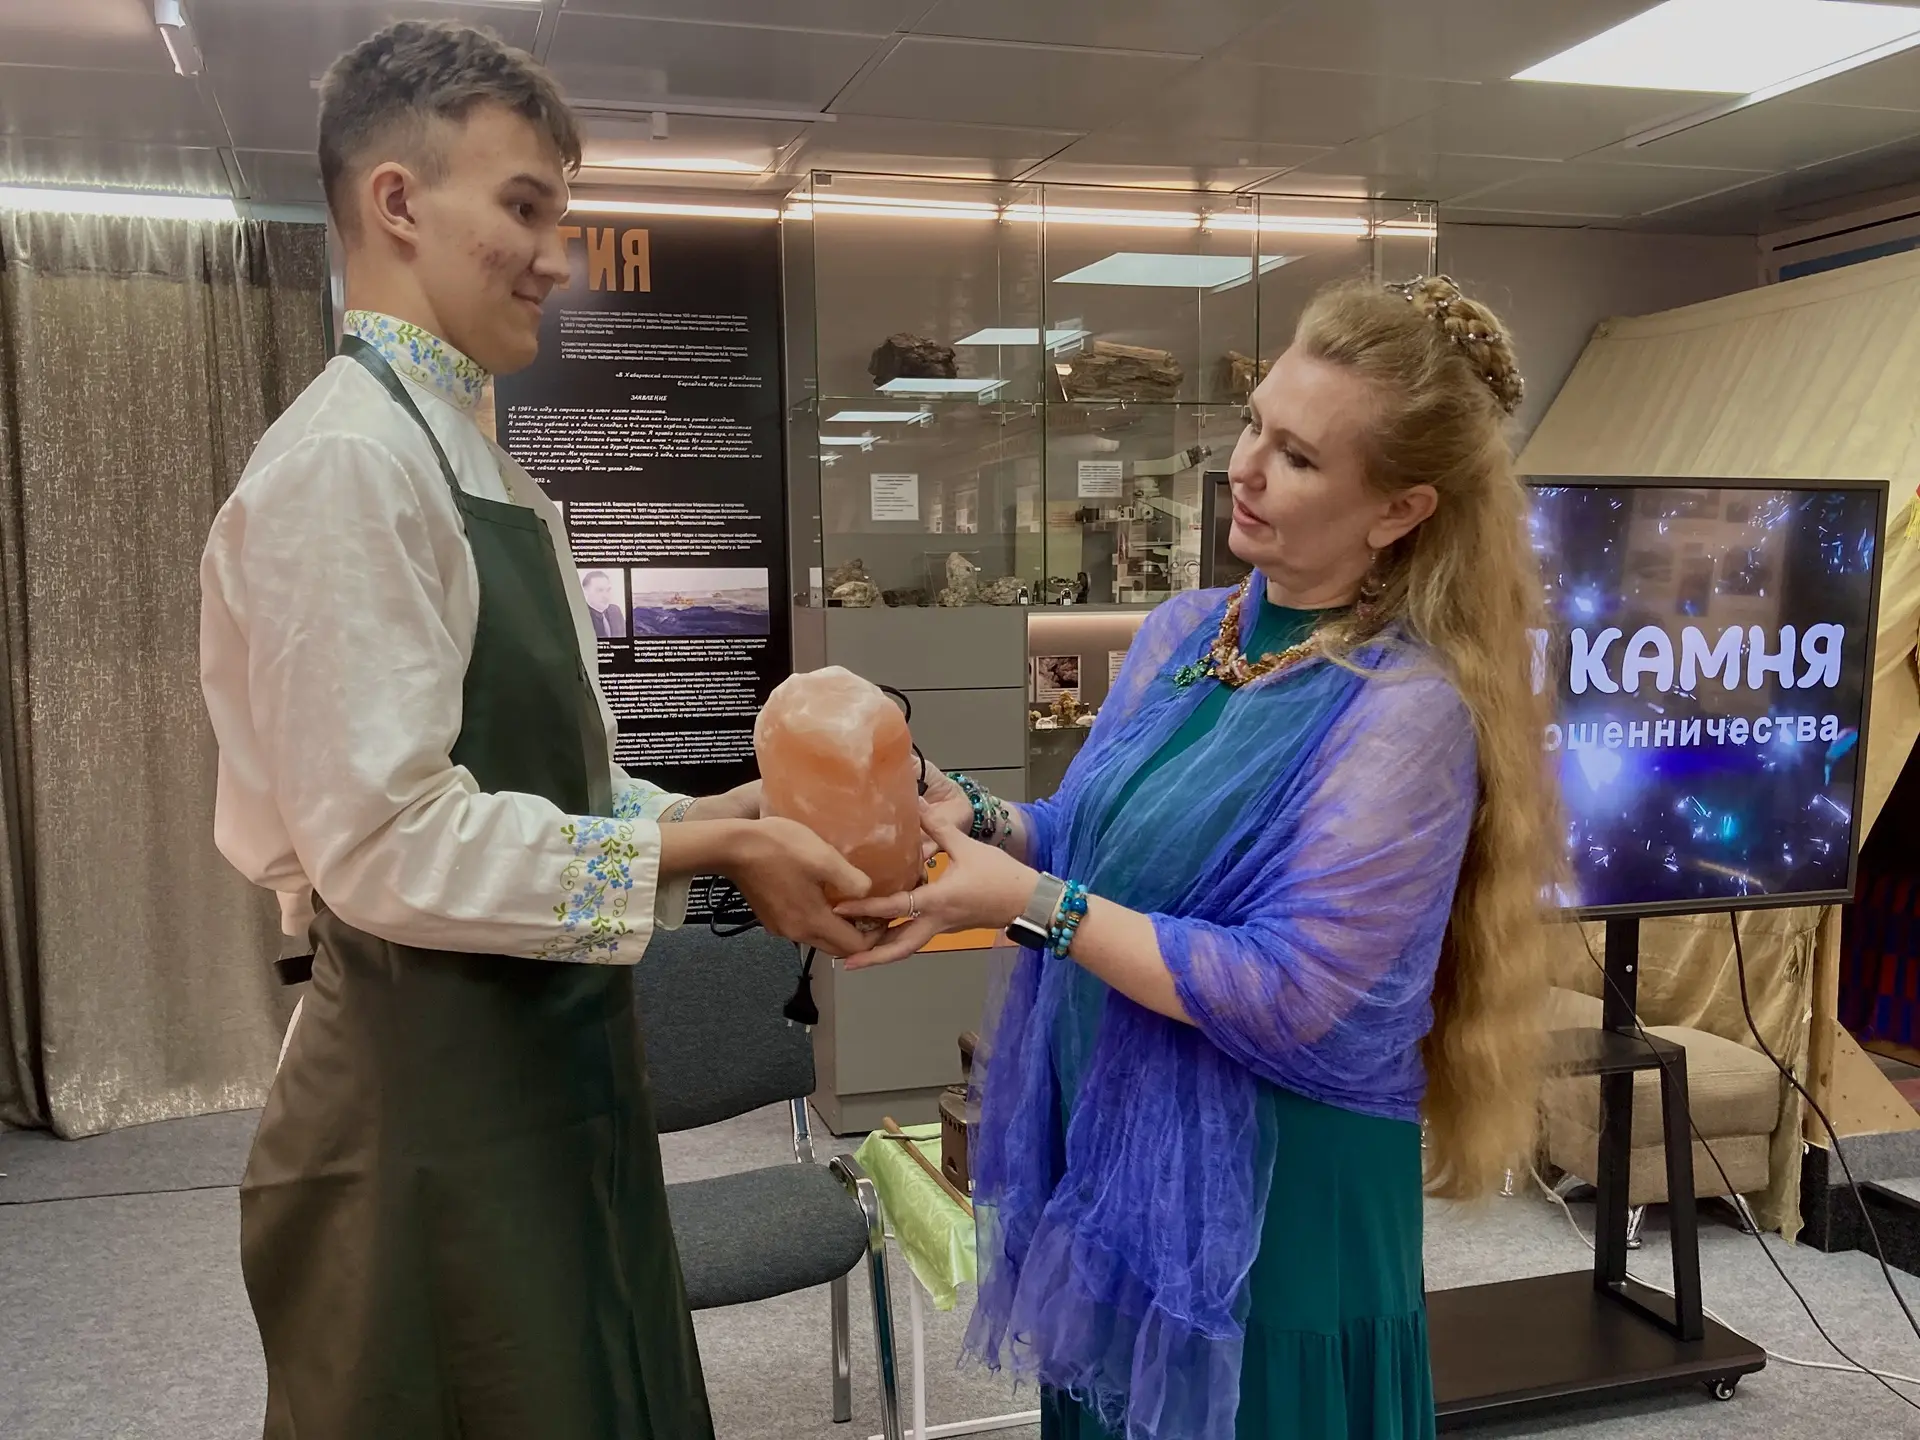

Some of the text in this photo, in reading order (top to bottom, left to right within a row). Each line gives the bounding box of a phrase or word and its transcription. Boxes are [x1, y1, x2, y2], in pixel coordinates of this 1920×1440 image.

[556, 226, 651, 292] ГИЯ
[1569, 622, 1845, 695] КАМНЯ
[1544, 713, 1839, 751] ошенничества
